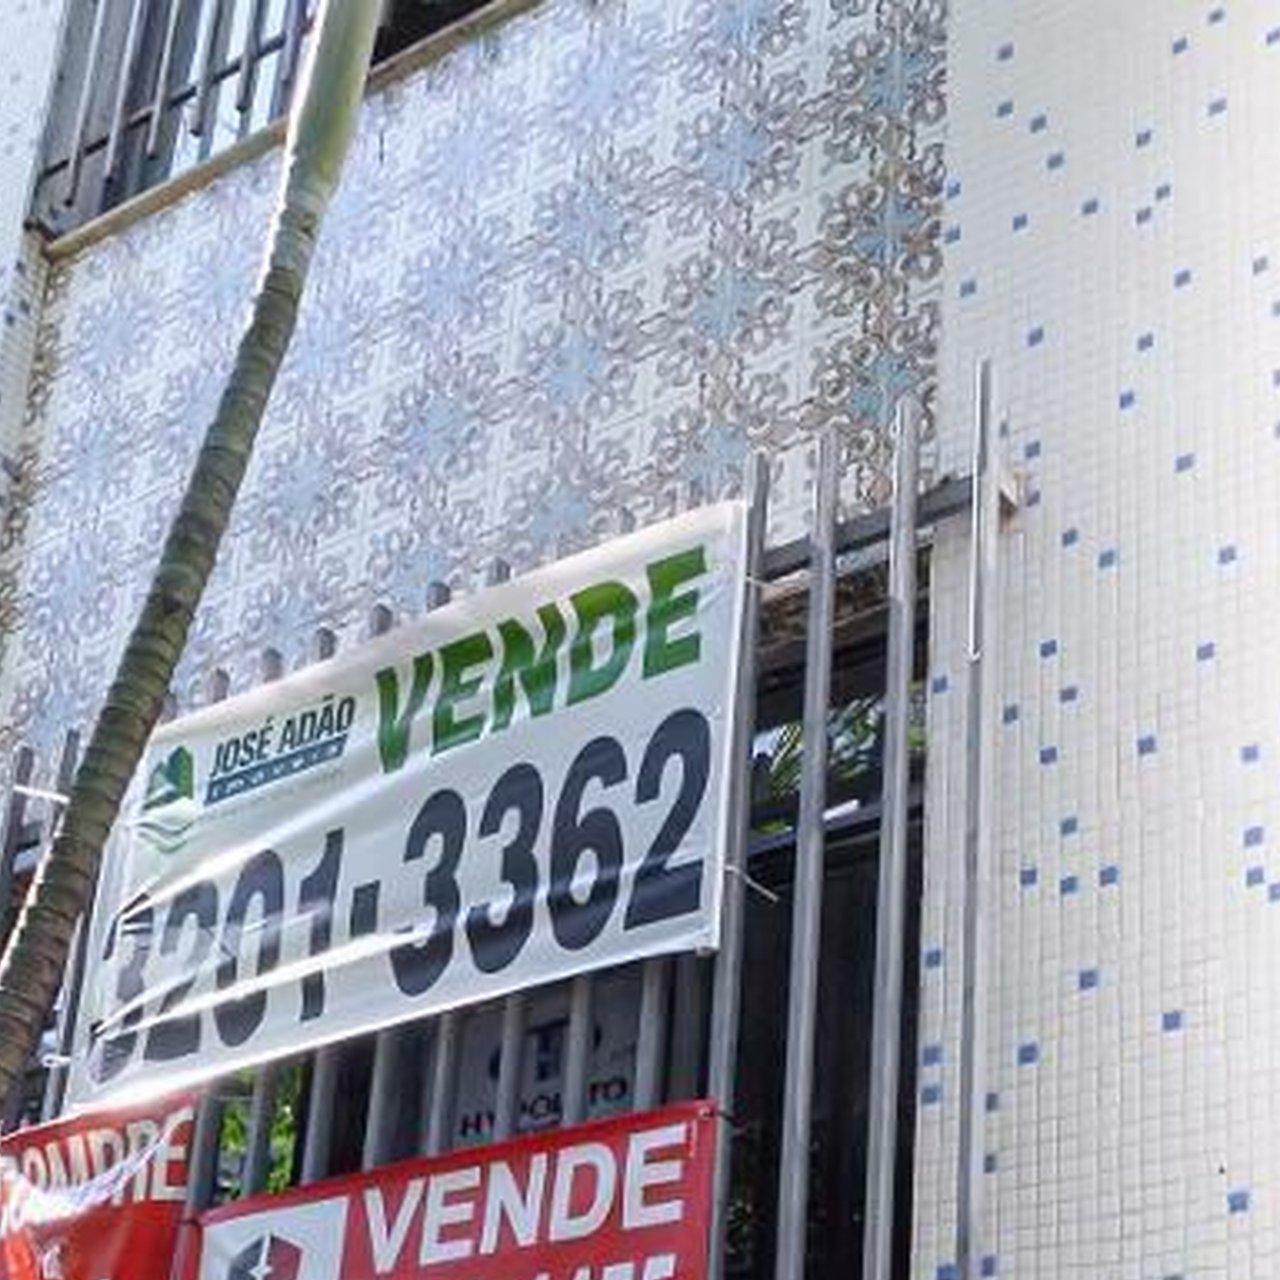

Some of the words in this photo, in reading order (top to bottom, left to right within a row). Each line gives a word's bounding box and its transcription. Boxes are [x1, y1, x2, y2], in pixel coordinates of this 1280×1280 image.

[209, 716, 274, 778] JOSÉ
[276, 693, 356, 754] ADÃO
[373, 544, 708, 775] VENDE
[363, 1121, 688, 1275] VENDE
